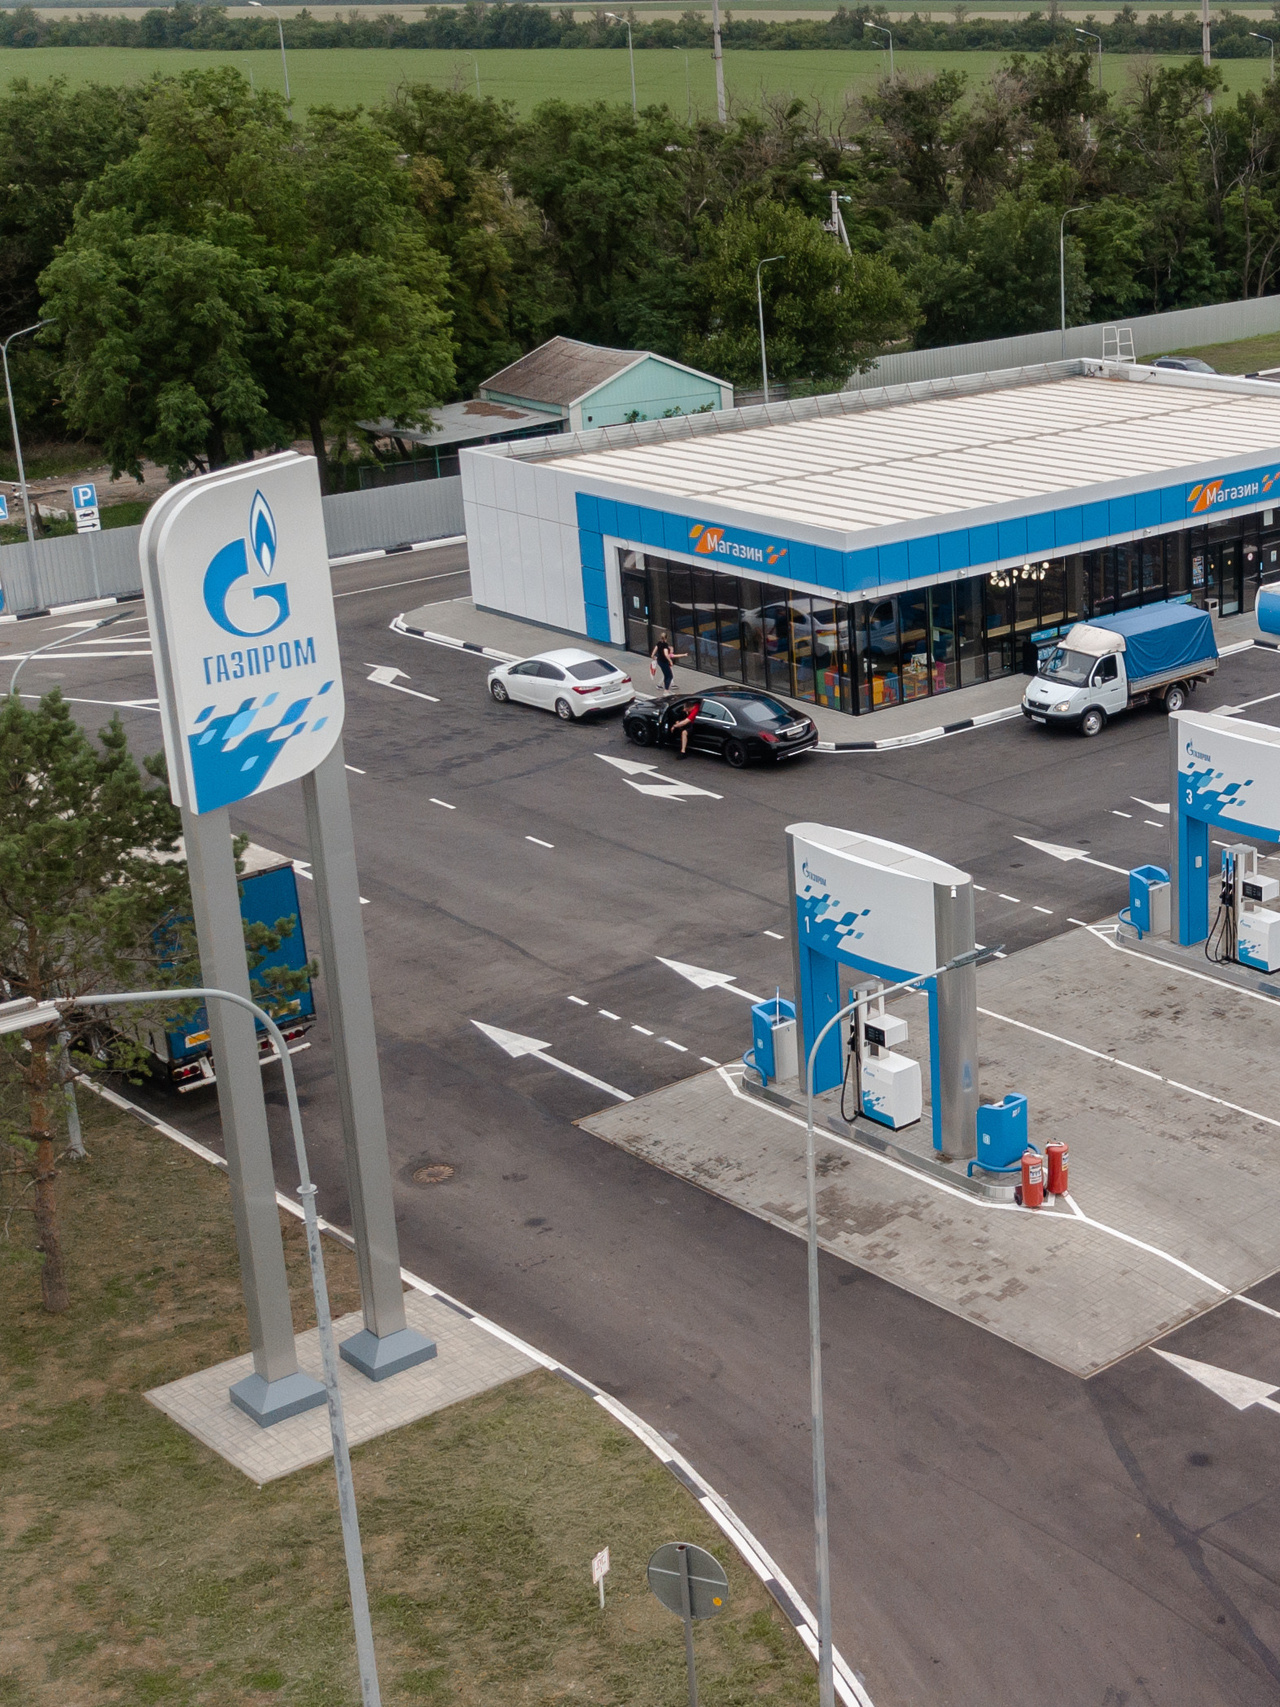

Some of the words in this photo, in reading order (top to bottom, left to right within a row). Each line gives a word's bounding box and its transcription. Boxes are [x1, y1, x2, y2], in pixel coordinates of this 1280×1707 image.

[79, 488, 91, 506] P
[1206, 482, 1259, 505] Магазин
[706, 532, 763, 562] Магазин
[203, 637, 316, 685] ГАЗПРОМ
[1186, 789, 1193, 805] 3
[804, 915, 810, 933] 1
